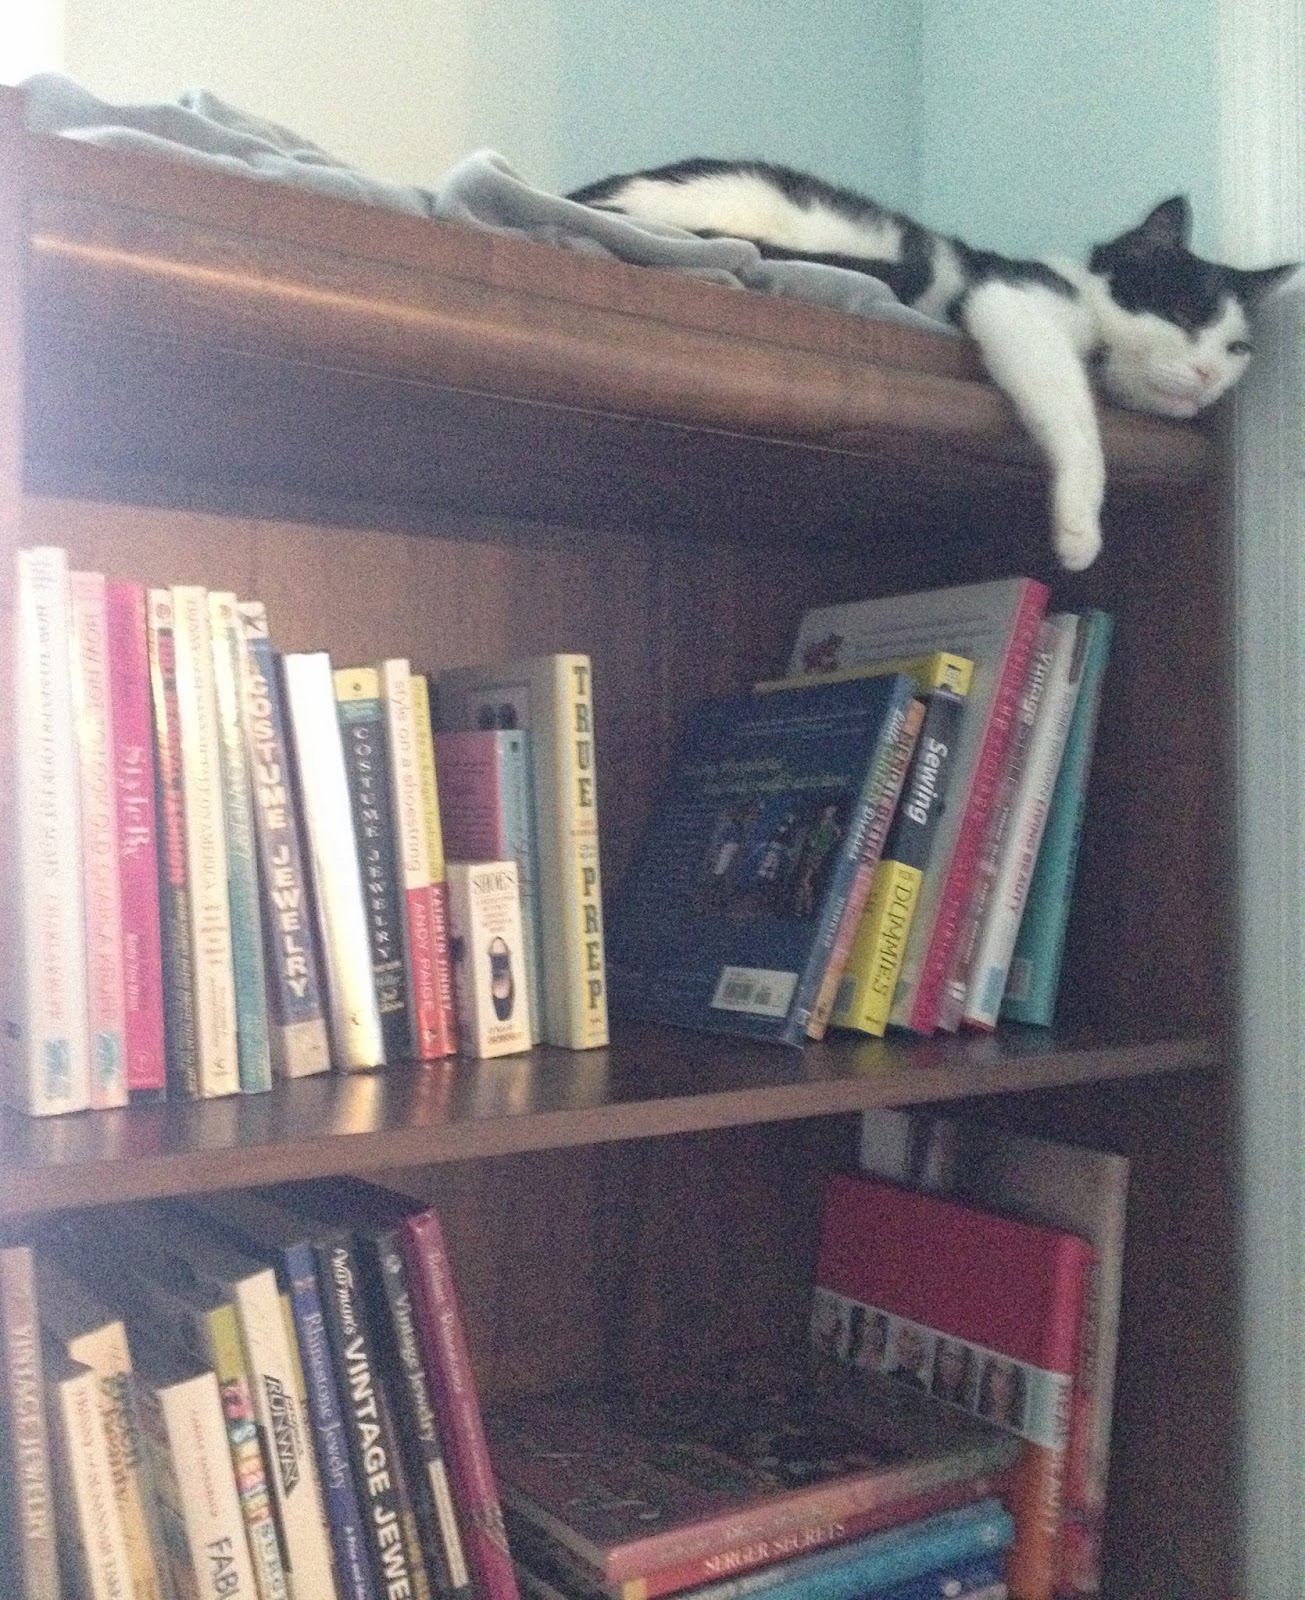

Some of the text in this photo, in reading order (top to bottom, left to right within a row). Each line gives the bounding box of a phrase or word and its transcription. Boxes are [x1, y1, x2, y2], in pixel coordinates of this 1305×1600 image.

[85, 614, 102, 662] HOW
[1017, 649, 1052, 727] Vintage
[389, 680, 411, 722] style
[398, 727, 412, 751] on
[570, 664, 596, 808] TRUE
[244, 672, 313, 999] COSTUME JEWELRY
[353, 725, 380, 839] COSTUME
[399, 773, 423, 872] shoestring
[909, 736, 947, 827] Sewing
[1026, 798, 1046, 851] LIVING
[366, 848, 391, 959] JEWELRY
[580, 865, 605, 1010] PREP
[1010, 851, 1032, 916] BEAUTY
[413, 902, 435, 1011] ANDY PAIGE
[430, 887, 452, 1011] KATHRYN FINNEY
[871, 883, 911, 998] DUMMIES
[10, 1324, 48, 1541] VINTAGE JEWELRY
[262, 1374, 301, 1488] RUNWAY
[303, 1310, 350, 1490] Rhinestone Jewelry
[344, 1335, 390, 1497] VINTAGE
